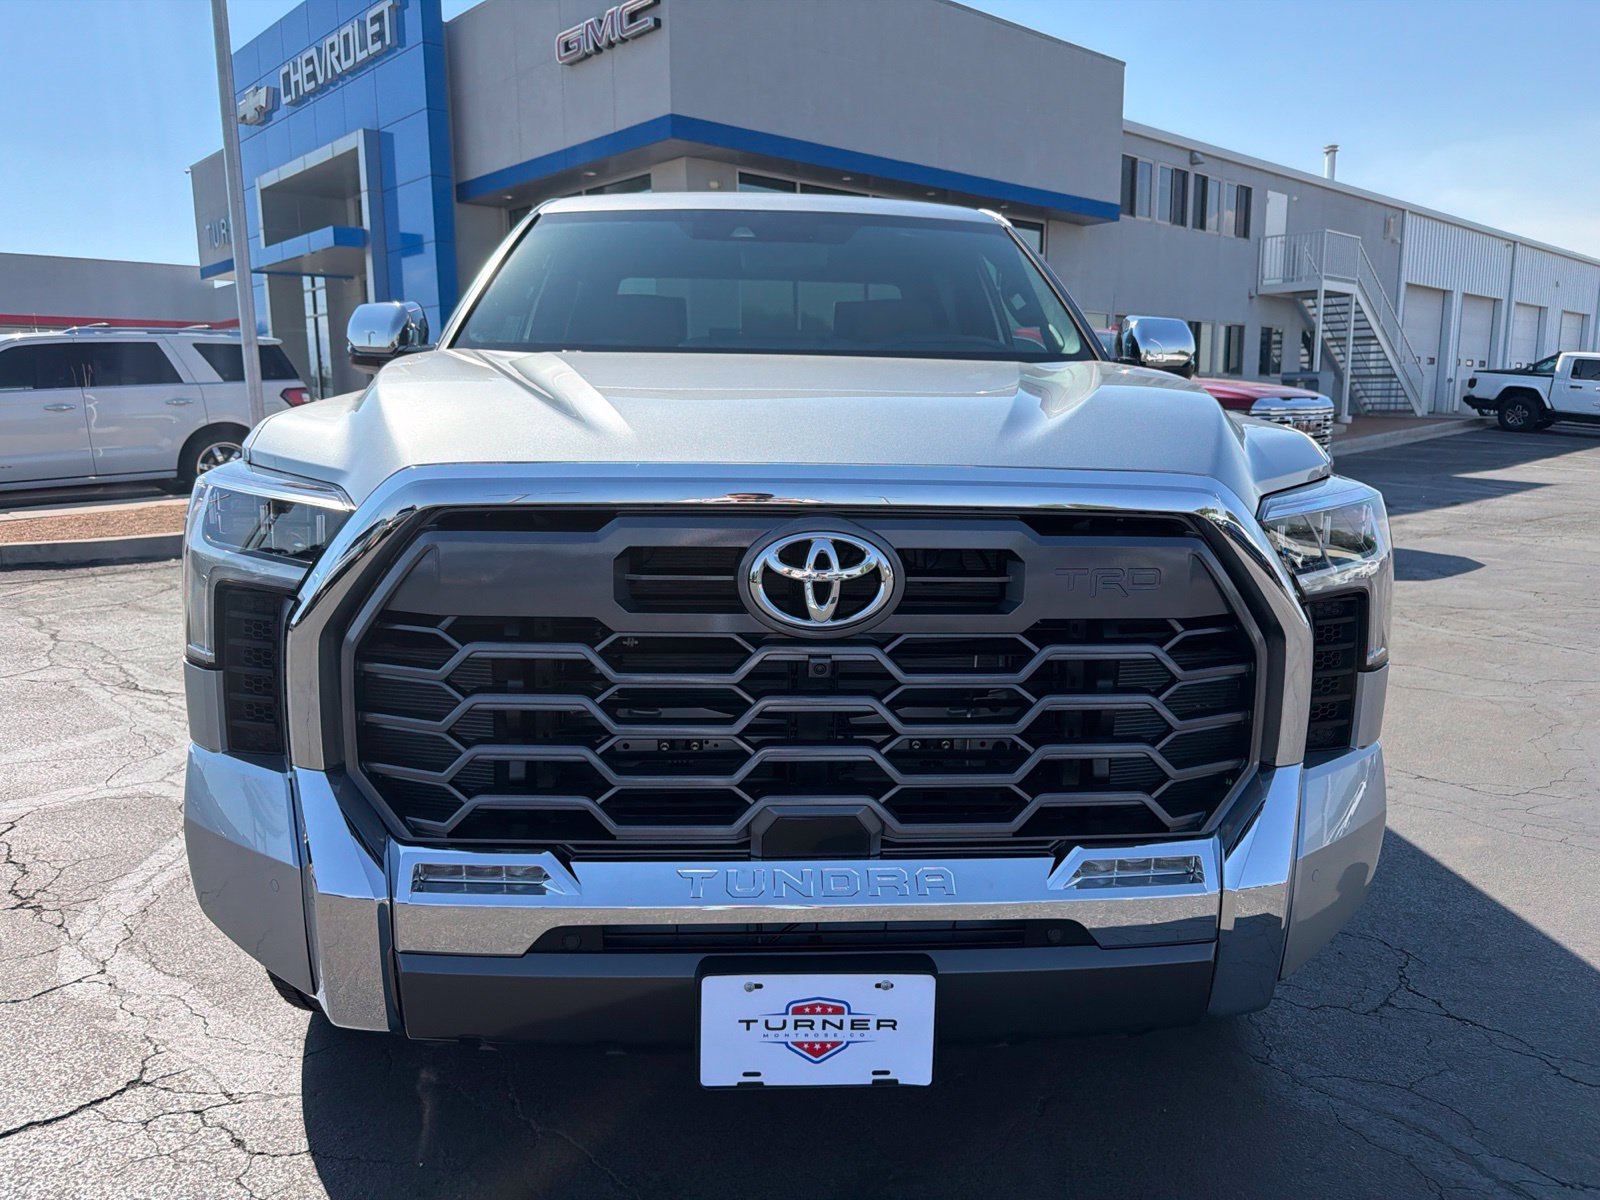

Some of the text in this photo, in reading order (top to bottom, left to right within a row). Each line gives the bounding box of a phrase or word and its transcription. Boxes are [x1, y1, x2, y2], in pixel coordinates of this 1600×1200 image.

[555, 0, 656, 64] GMC
[279, 0, 394, 105] CHEVROLET
[205, 218, 228, 248] TUR
[1055, 567, 1161, 598] TRD
[677, 867, 957, 899] TUNDRA
[738, 1019, 898, 1031] TURNER
